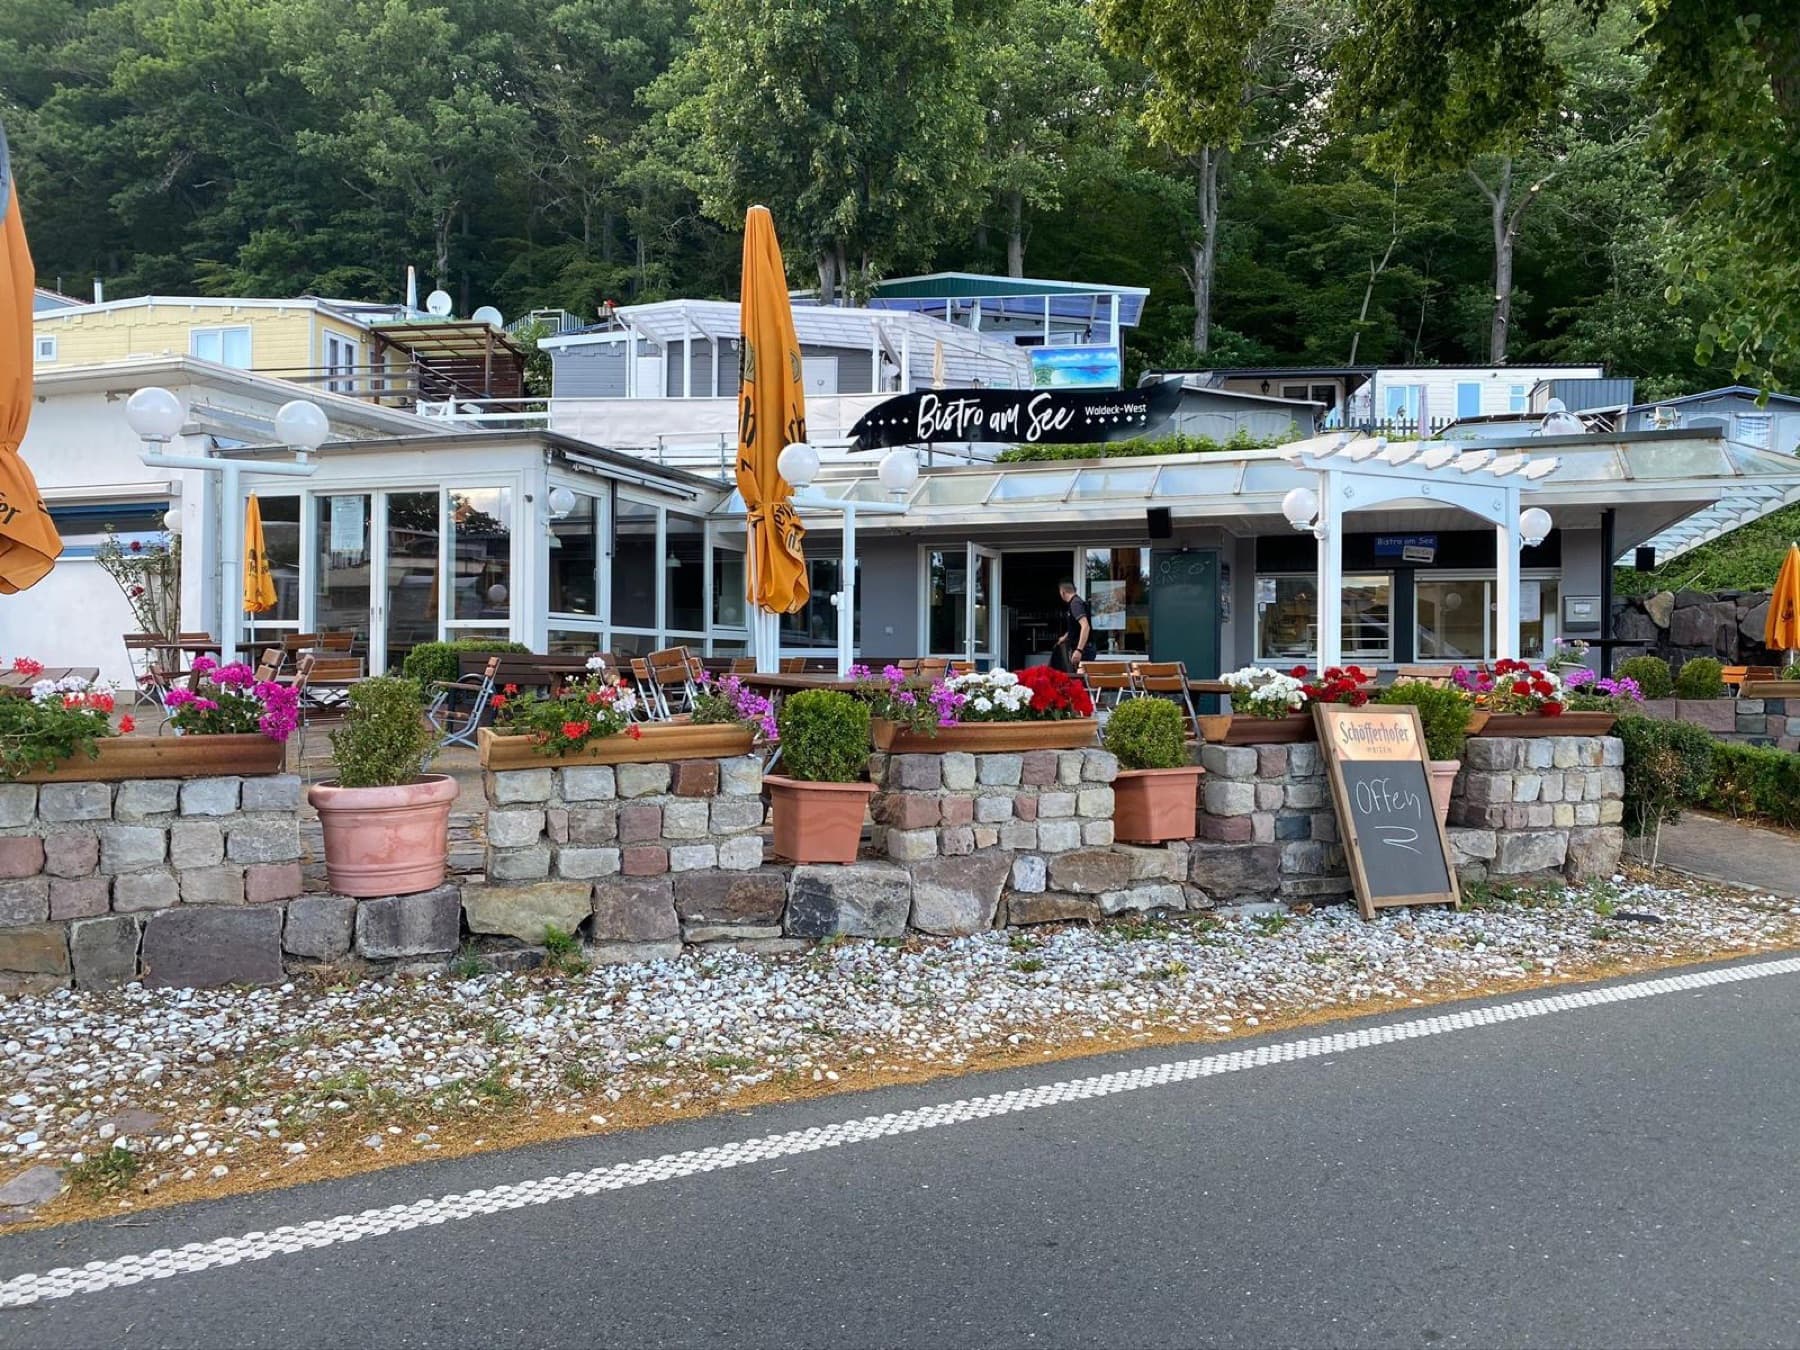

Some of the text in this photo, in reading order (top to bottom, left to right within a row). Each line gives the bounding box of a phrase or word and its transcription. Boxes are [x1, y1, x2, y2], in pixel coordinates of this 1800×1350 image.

[917, 392, 1075, 442] Bistro am See
[1085, 404, 1147, 416] Waldeck-West
[1340, 721, 1408, 745] Schöfferhofer
